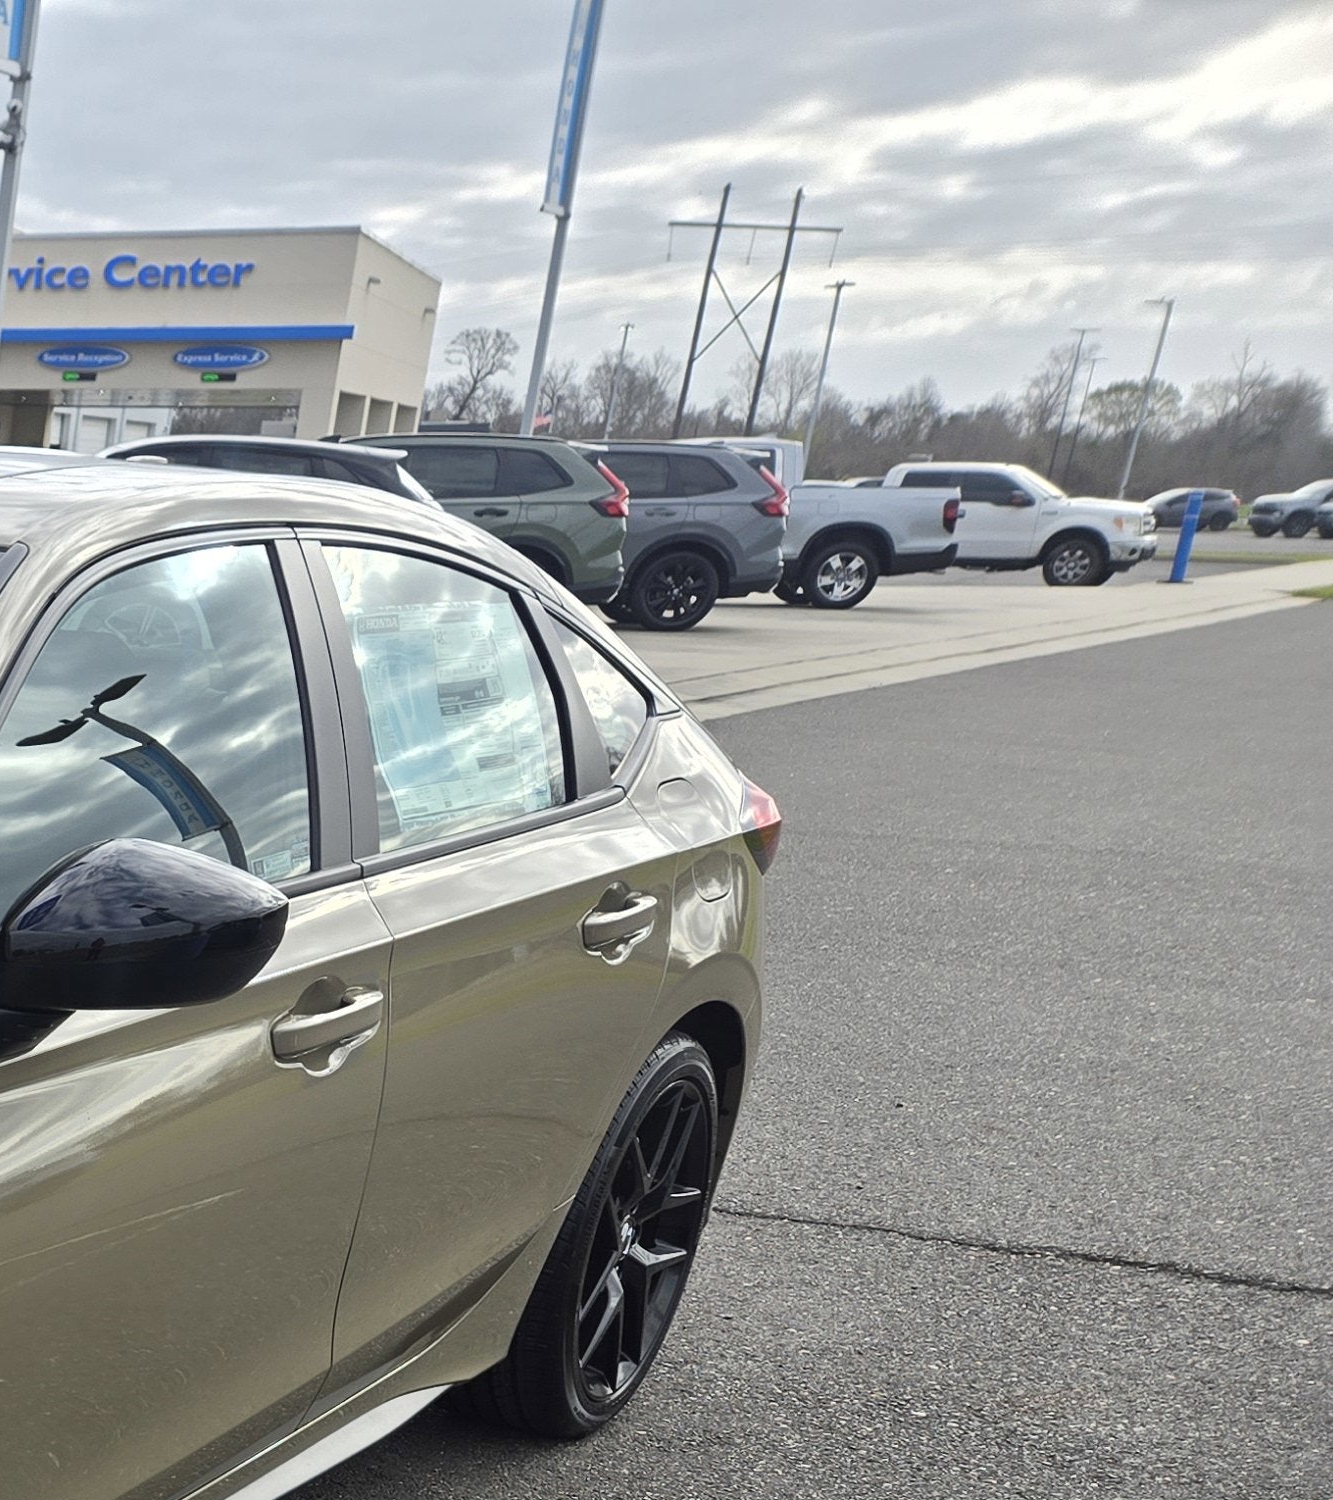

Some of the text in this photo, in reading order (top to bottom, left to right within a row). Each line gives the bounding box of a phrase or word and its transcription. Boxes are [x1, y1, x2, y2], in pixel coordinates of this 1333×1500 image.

[104, 254, 255, 290] Center
[42, 351, 123, 364] Service Reception
[176, 351, 248, 364] Express Service
[365, 616, 399, 630] HONDA
